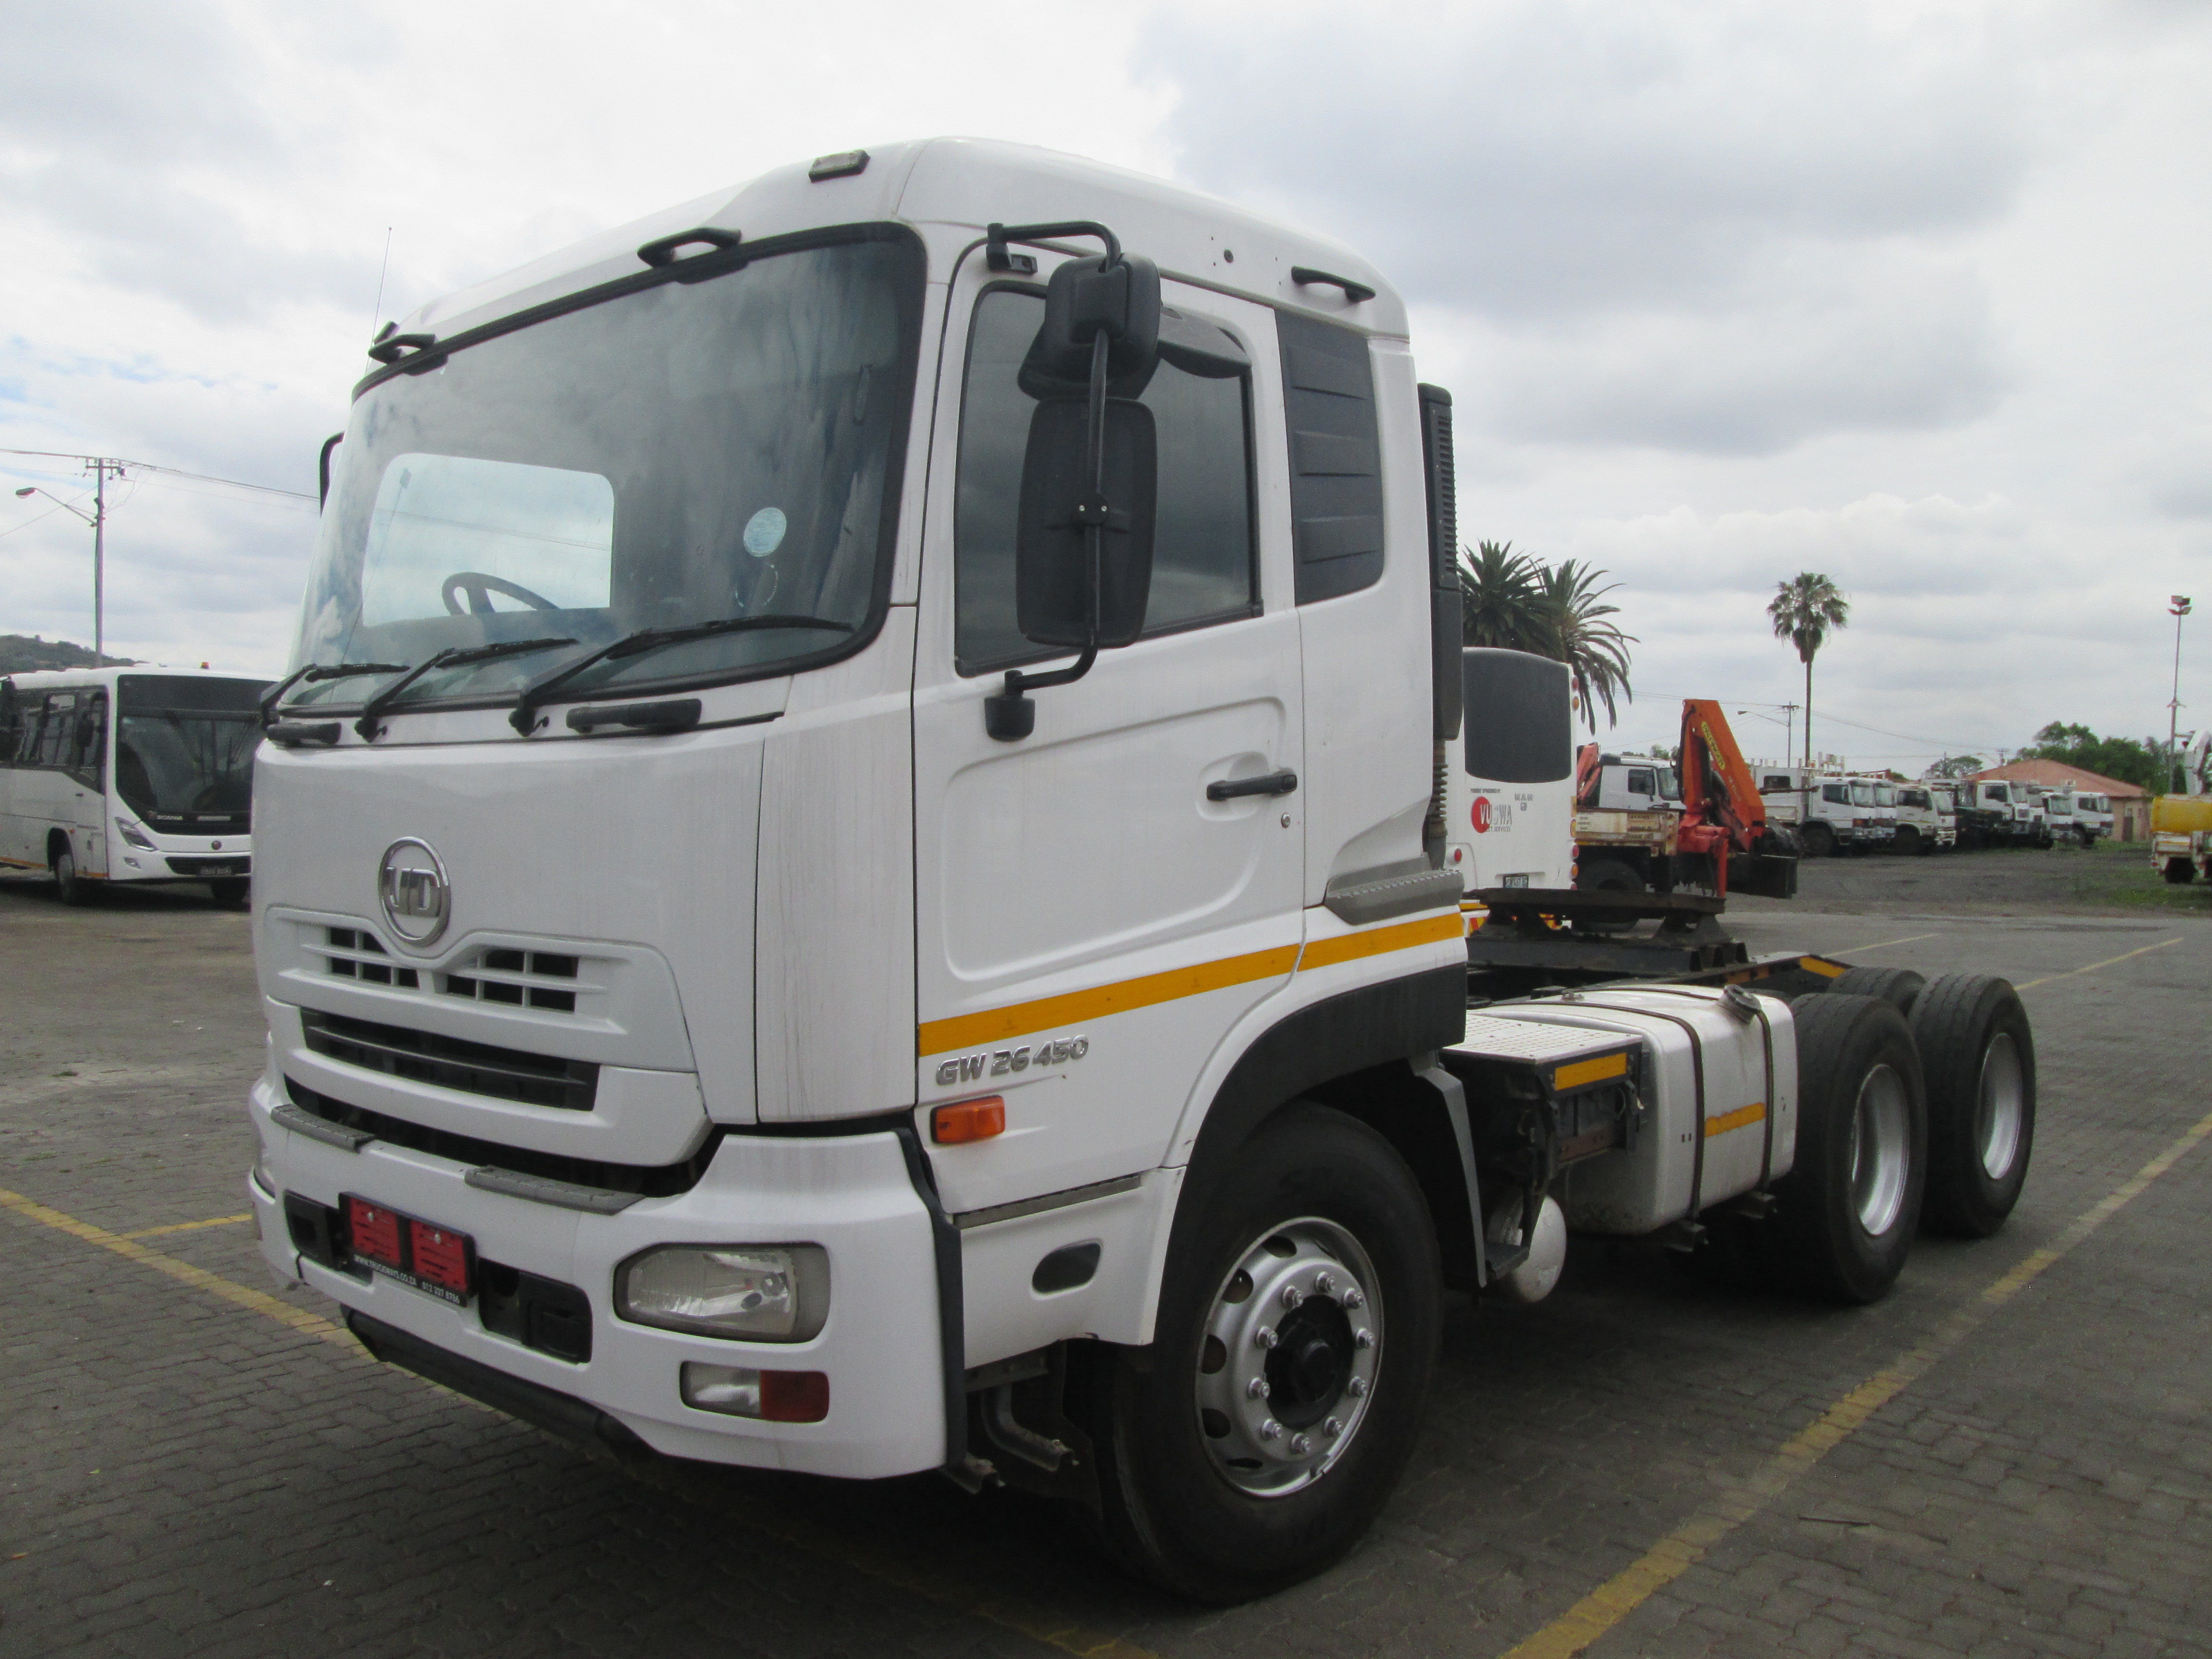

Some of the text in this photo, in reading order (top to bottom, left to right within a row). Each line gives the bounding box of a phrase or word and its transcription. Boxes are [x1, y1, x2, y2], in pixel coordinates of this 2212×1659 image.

[383, 866, 441, 918] UD
[936, 1034, 1089, 1086] GW 26 450
